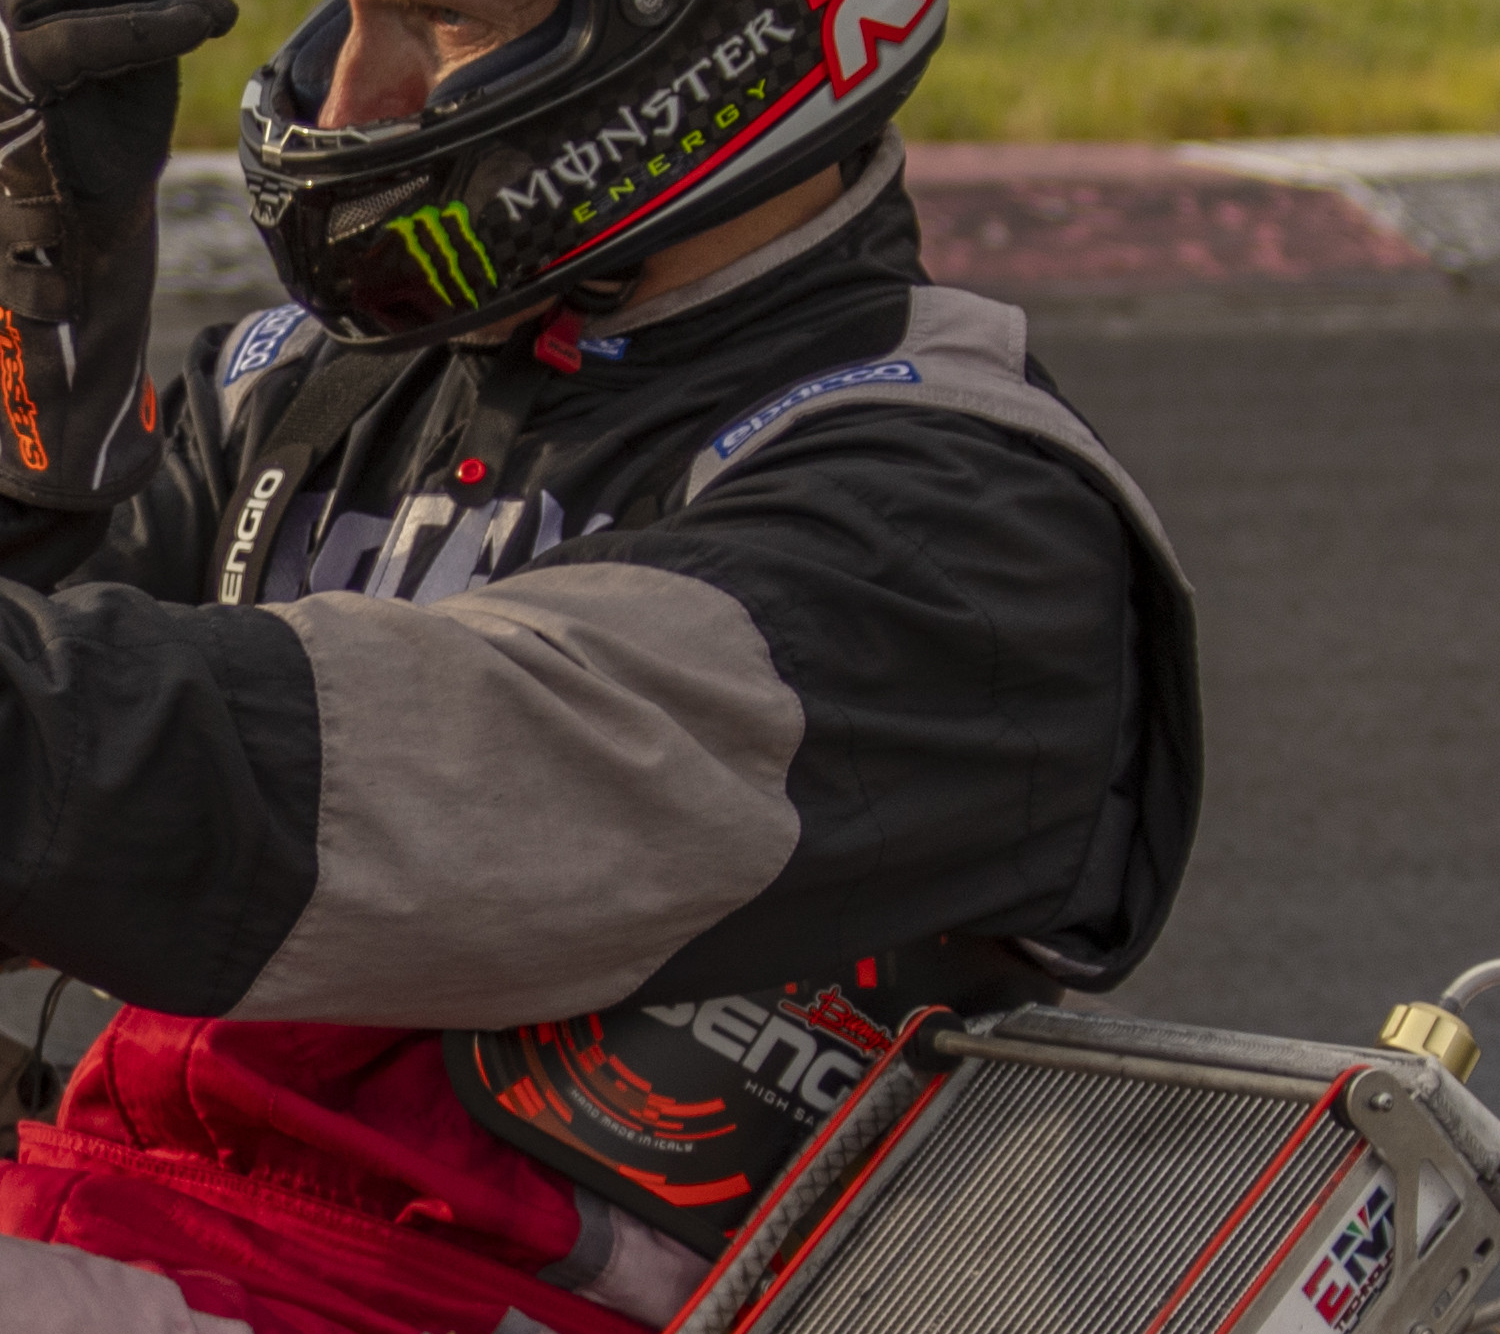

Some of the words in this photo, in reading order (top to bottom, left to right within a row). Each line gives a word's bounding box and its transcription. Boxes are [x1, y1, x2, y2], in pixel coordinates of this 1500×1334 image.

[497, 8, 796, 221] MONSTER
[572, 78, 766, 224] ENERGY
[744, 1080, 788, 1113] HIGH
